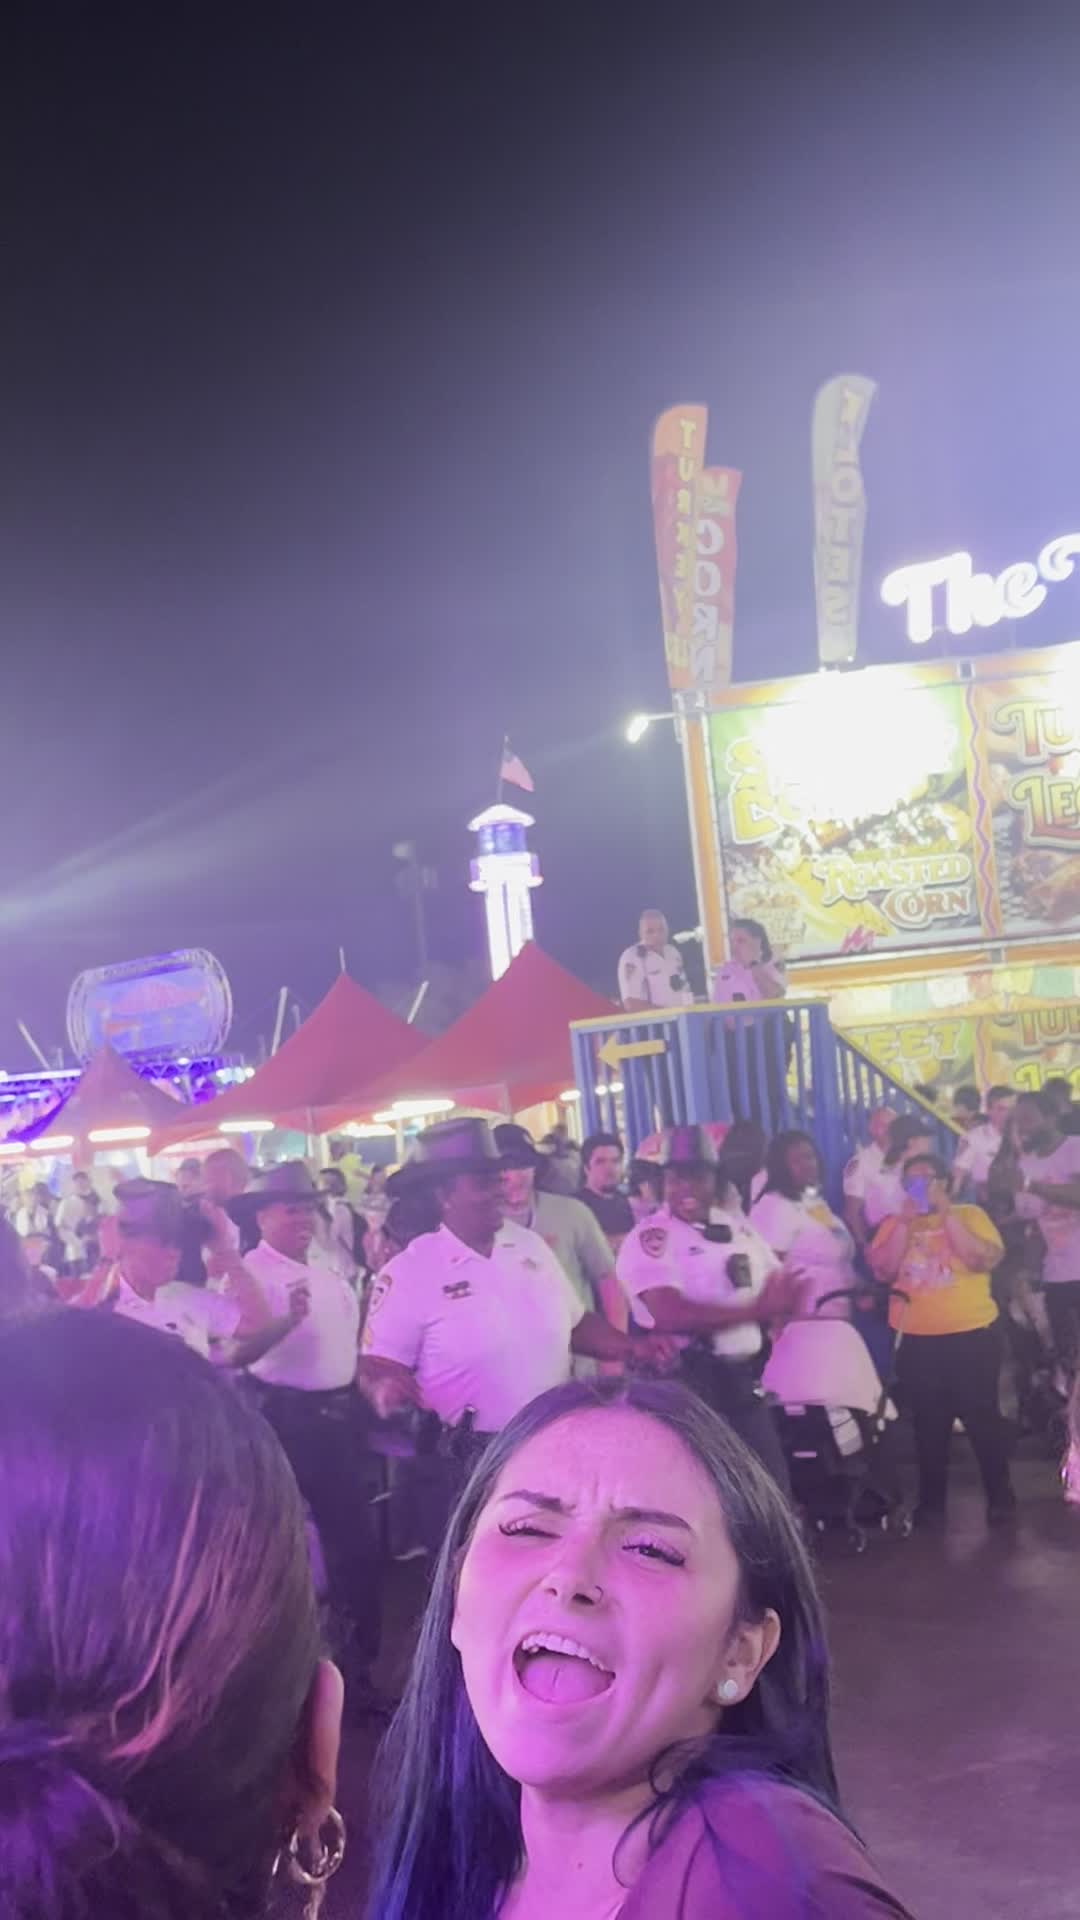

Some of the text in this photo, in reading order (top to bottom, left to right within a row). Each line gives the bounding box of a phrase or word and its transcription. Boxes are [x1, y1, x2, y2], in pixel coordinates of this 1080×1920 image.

[880, 551, 1047, 645] The
[814, 857, 968, 903] ROASTED
[883, 888, 971, 927] CORN
